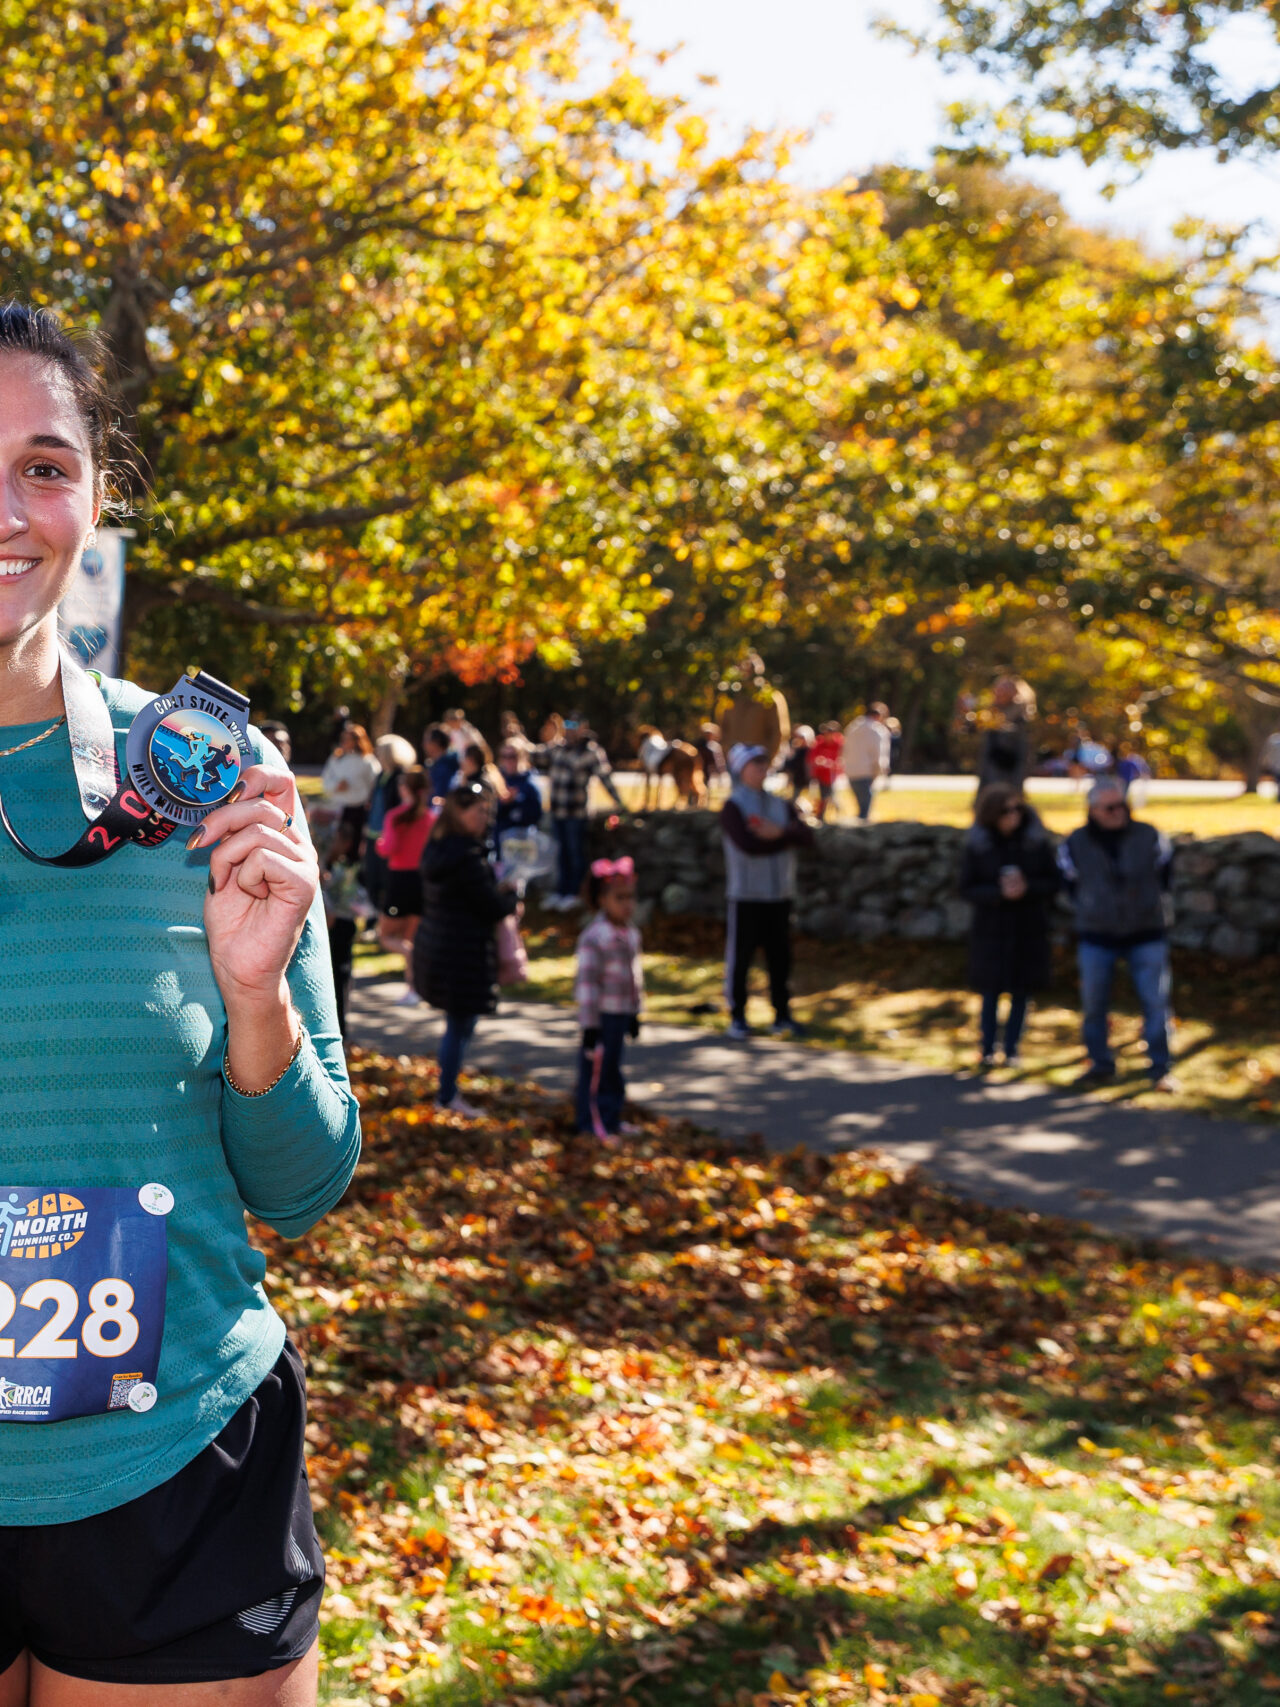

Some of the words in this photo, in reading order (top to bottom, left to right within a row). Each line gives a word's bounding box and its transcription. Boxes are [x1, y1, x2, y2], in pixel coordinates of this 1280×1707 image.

[154, 695, 185, 714] COLT
[190, 696, 229, 723] STATE
[132, 763, 157, 796] HALF
[154, 795, 220, 823] MARATH
[12, 1211, 89, 1237] NORTH
[10, 1234, 56, 1247] RUNNING
[58, 1232, 73, 1242] CO.
[13, 1385, 52, 1405] RRCA
